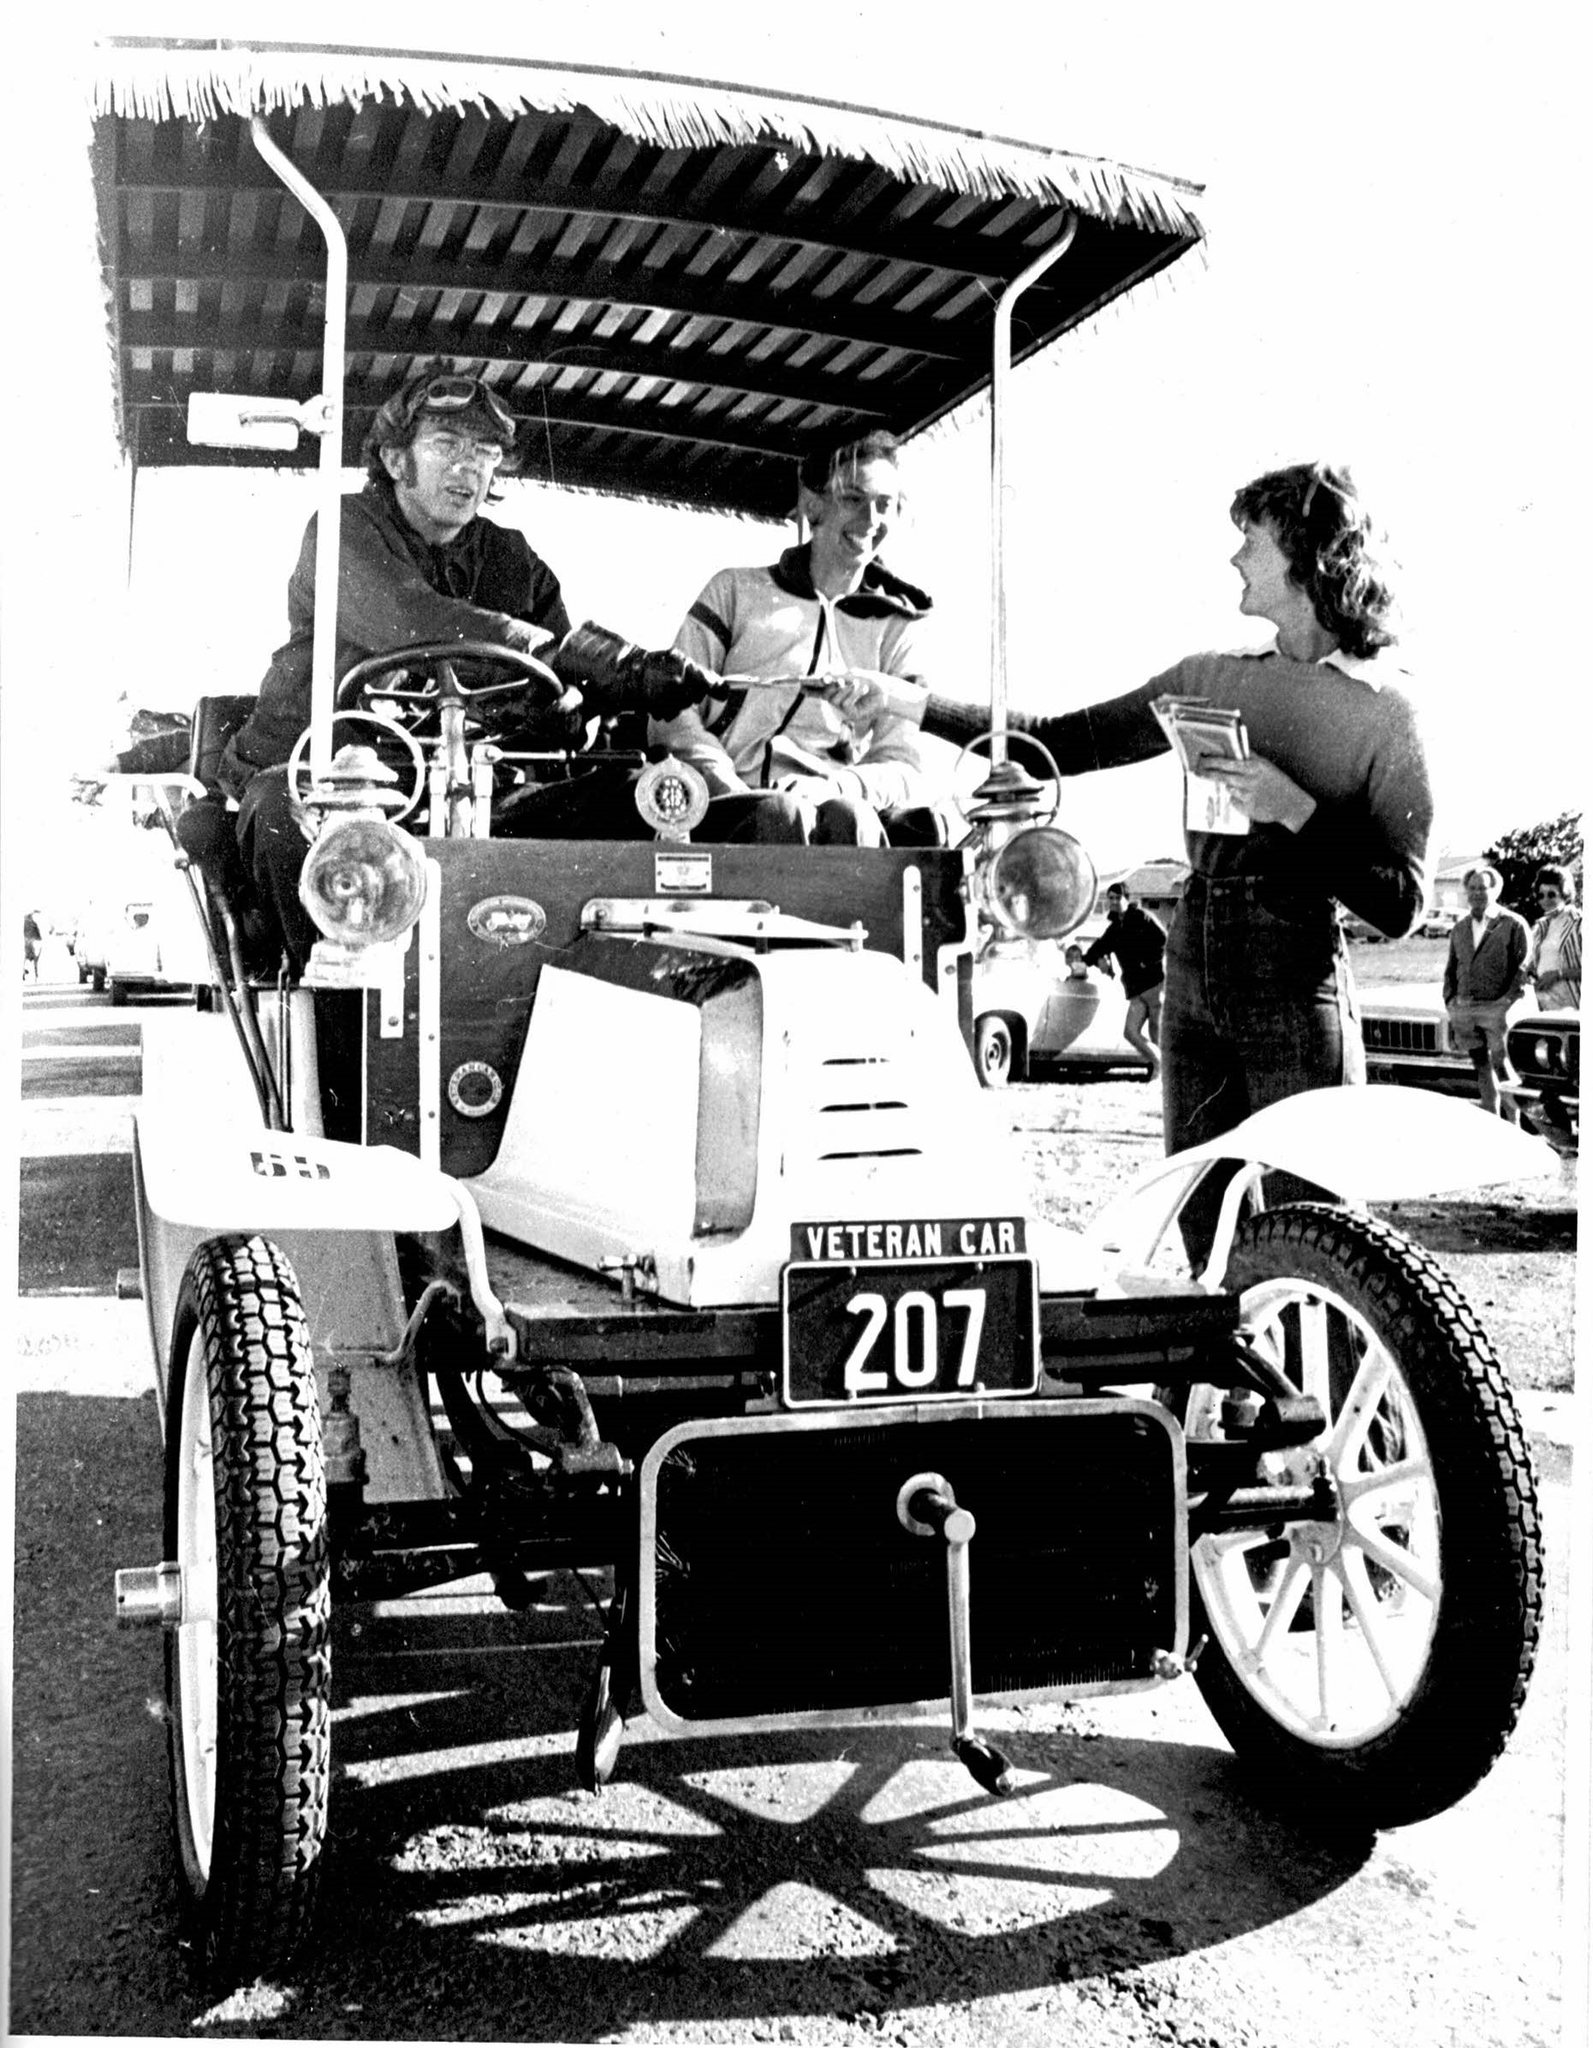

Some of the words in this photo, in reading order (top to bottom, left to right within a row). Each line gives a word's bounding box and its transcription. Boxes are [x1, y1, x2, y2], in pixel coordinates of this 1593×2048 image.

[806, 1223, 942, 1260] VETERAN
[959, 1221, 1016, 1254] CAR
[844, 1288, 987, 1390] 207
